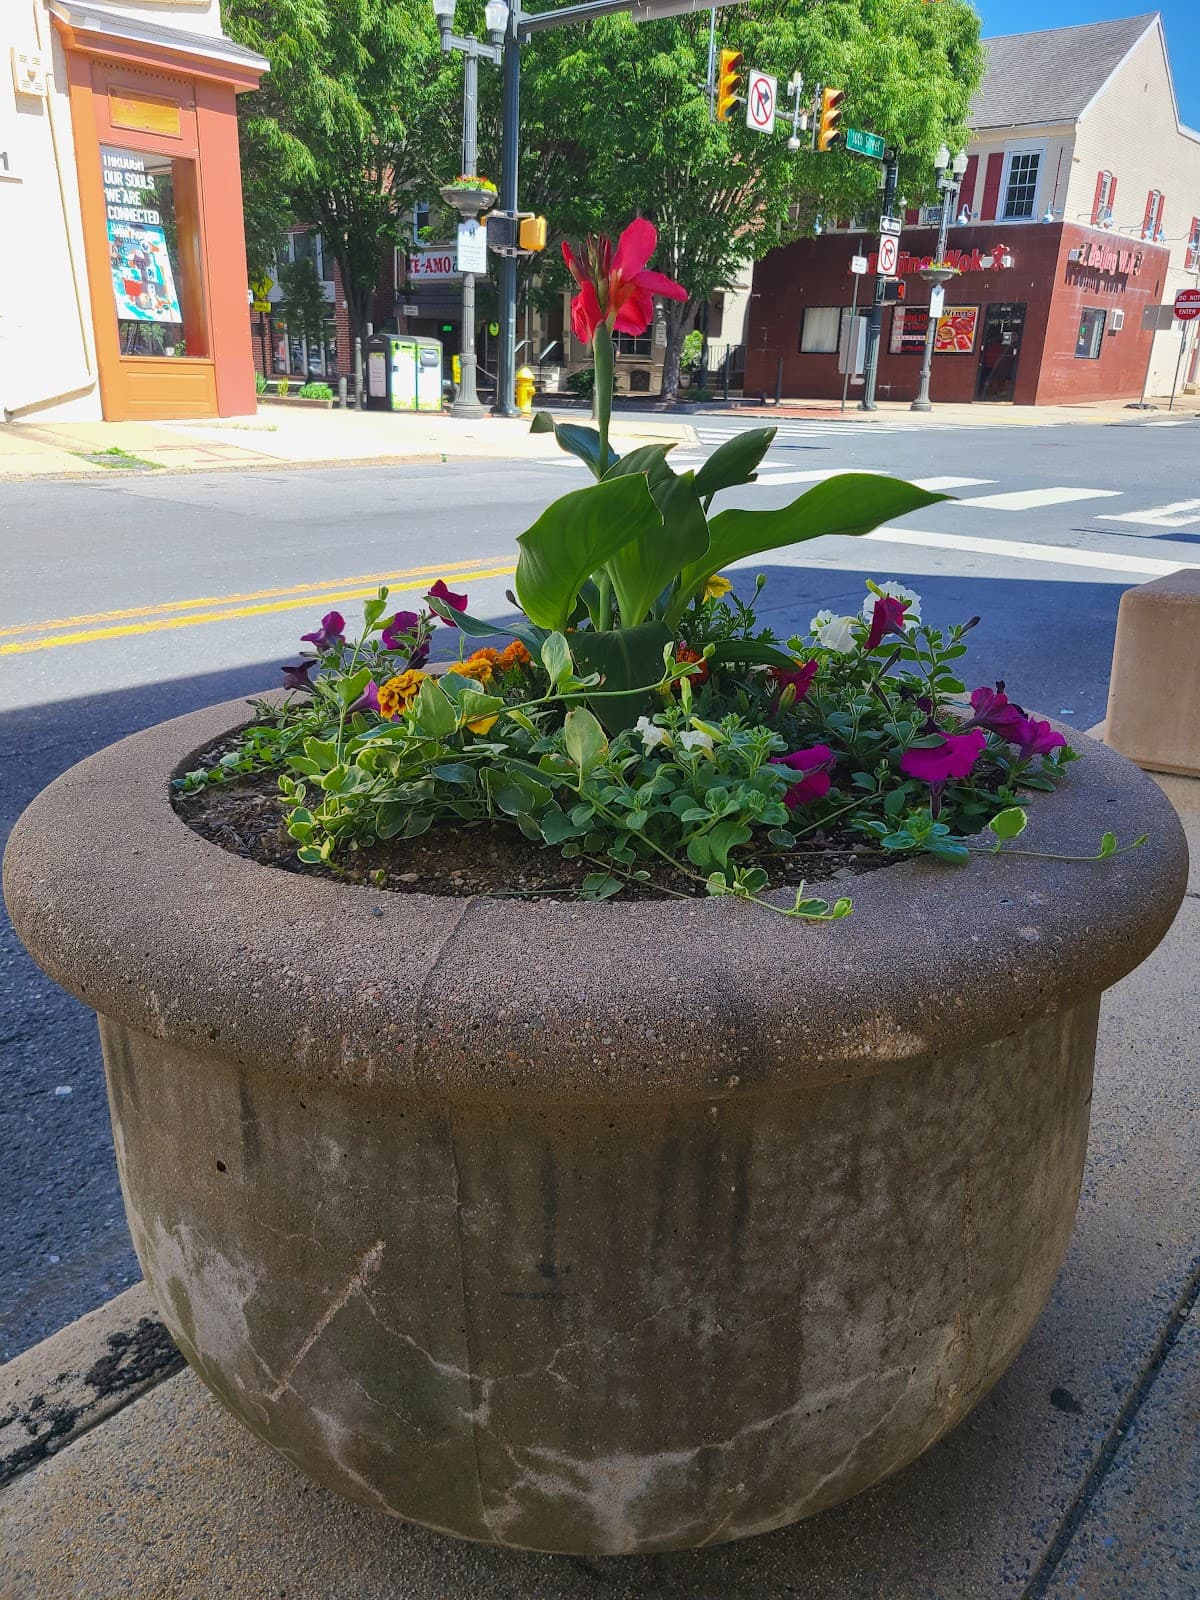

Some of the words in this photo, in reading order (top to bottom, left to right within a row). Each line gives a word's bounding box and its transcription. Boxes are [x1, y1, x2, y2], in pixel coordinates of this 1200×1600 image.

[865, 136, 881, 152] Street
[103, 169, 124, 186] OUR
[124, 172, 154, 190] SOULS
[105, 187, 121, 203] WE
[122, 189, 142, 206] ARE
[107, 205, 160, 225] CONNECTED
[943, 248, 985, 272] Wok
[1088, 242, 1117, 276] Beijing
